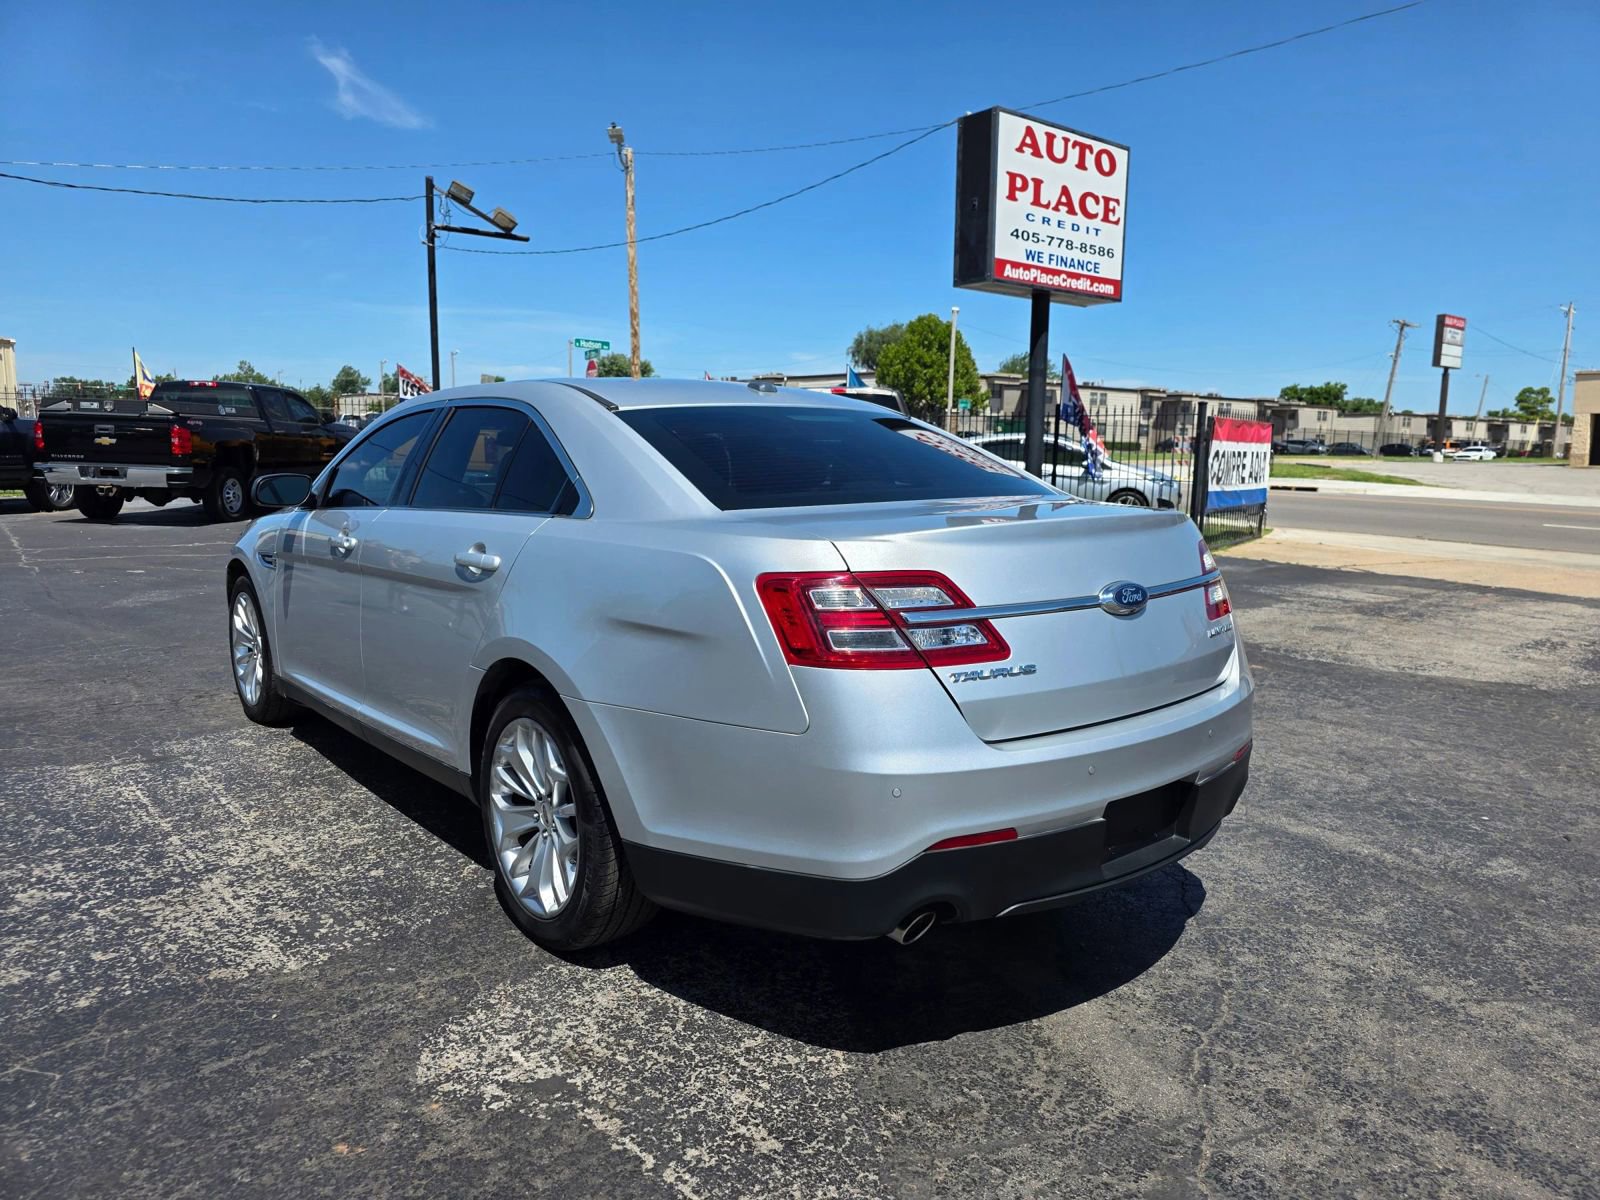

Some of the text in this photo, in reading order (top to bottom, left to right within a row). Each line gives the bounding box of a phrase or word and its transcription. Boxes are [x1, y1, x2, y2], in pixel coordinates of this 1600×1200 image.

[1015, 125, 1117, 177] AUTO
[1005, 170, 1121, 226] PLACE
[1025, 212, 1102, 237] CREDIT
[1010, 228, 1115, 259] 405-778-8586
[1025, 248, 1101, 274] WE FINANCE
[1004, 263, 1115, 295] AutoPlaceCredit.com
[1210, 450, 1247, 485] COMPRE
[1121, 587, 1143, 604] Ford
[949, 664, 1037, 684] TAURUS
